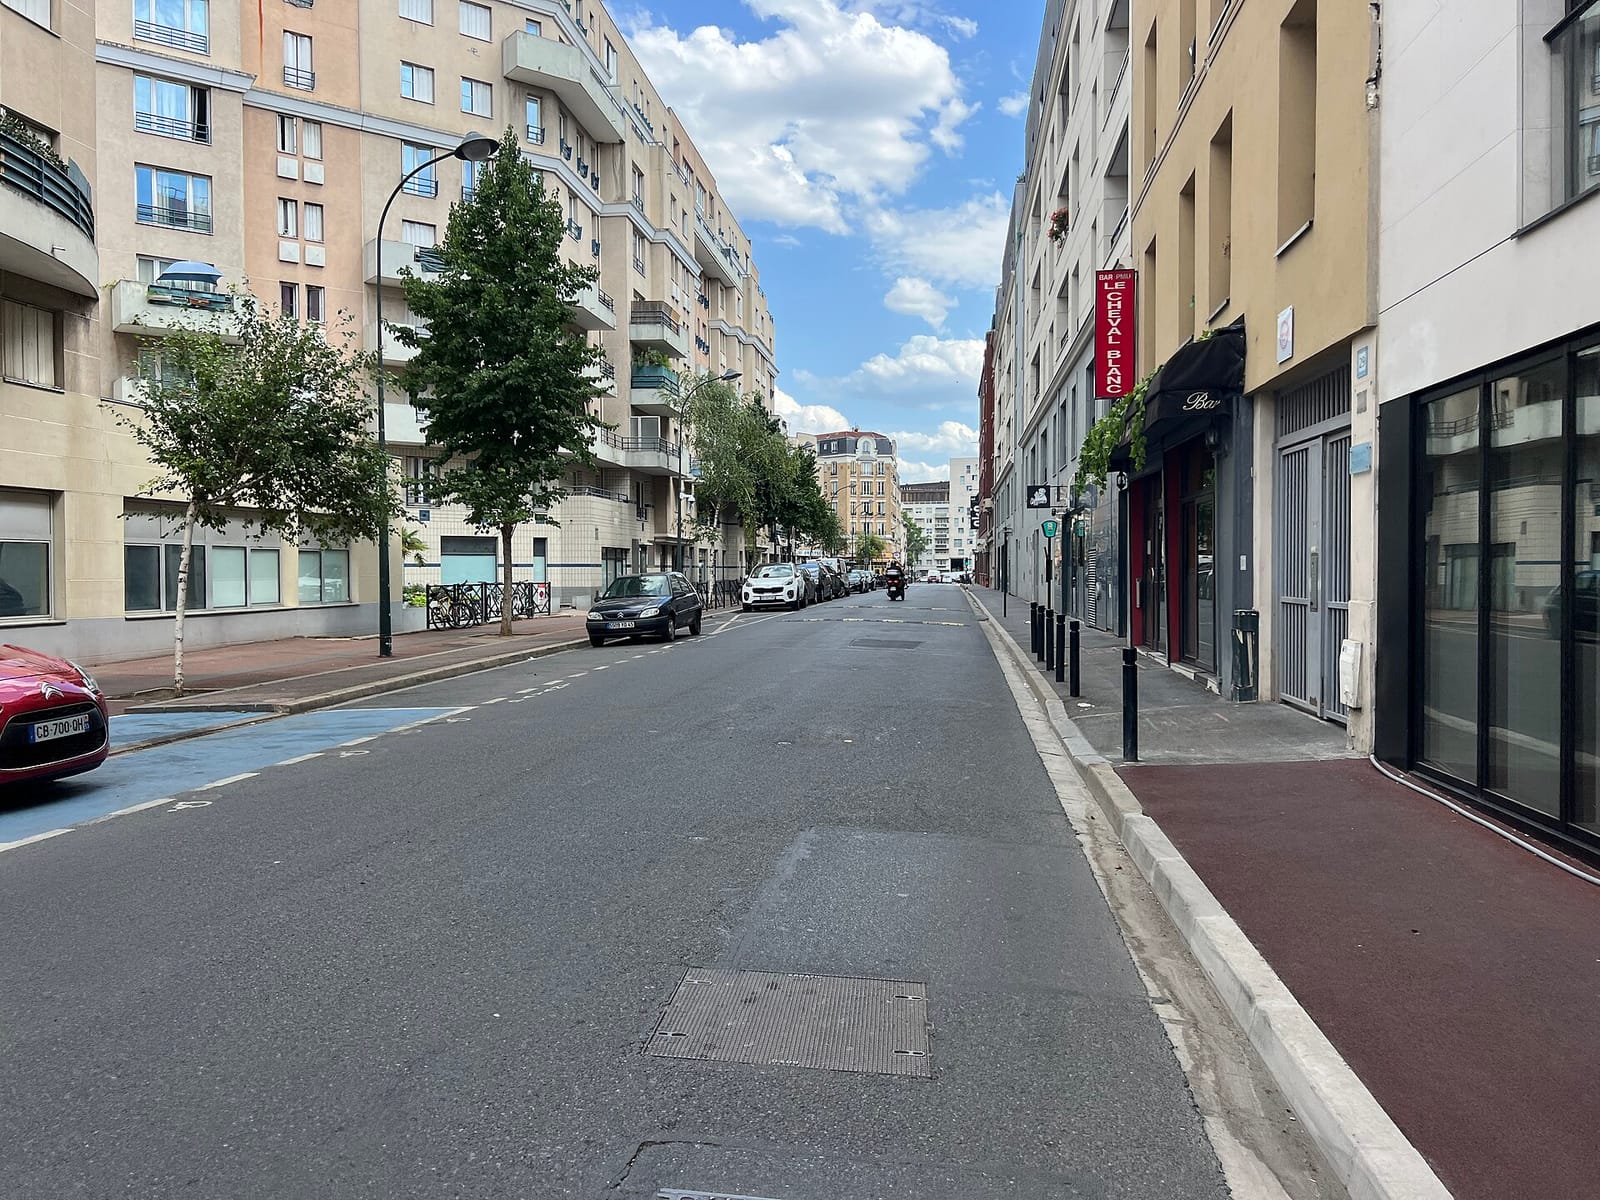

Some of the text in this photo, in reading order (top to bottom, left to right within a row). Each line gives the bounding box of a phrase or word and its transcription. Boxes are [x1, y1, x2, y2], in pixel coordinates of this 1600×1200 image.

[1104, 281, 1126, 394] LE CHEVAL BLANC
[1182, 391, 1221, 411] Bar
